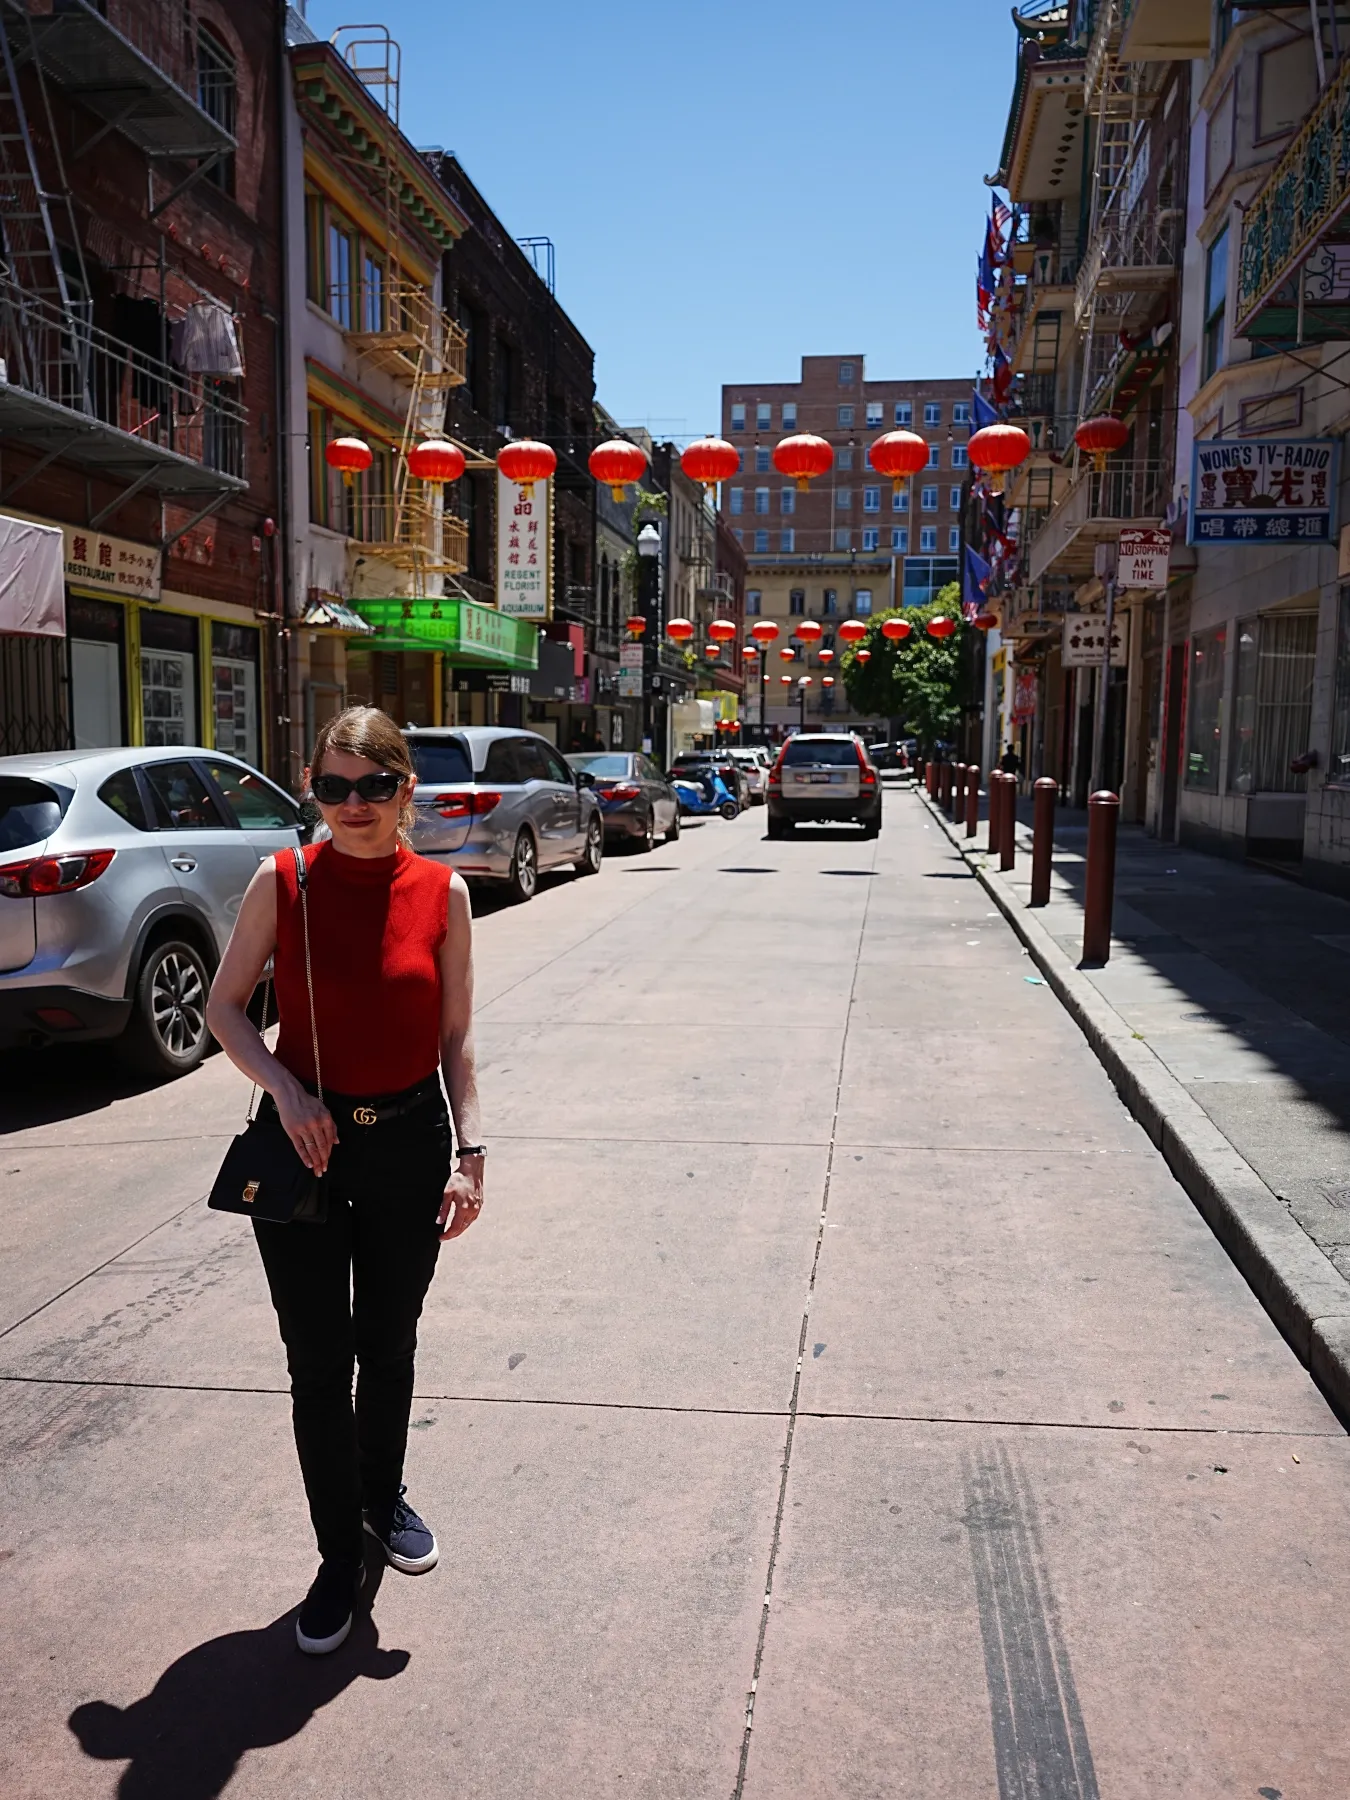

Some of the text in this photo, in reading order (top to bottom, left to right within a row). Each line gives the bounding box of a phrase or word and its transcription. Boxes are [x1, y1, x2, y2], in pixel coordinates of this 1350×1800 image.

[1199, 445, 1330, 471] WONG'S TV-RADIO
[1120, 542, 1168, 556] NO STOPPING
[1134, 559, 1153, 568] ANY
[68, 563, 115, 583] RESTAURANT
[504, 570, 541, 579] REGENT
[1132, 570, 1154, 580] TIME
[504, 581, 541, 591] FLORIST
[501, 604, 544, 613] AQUARIUM
